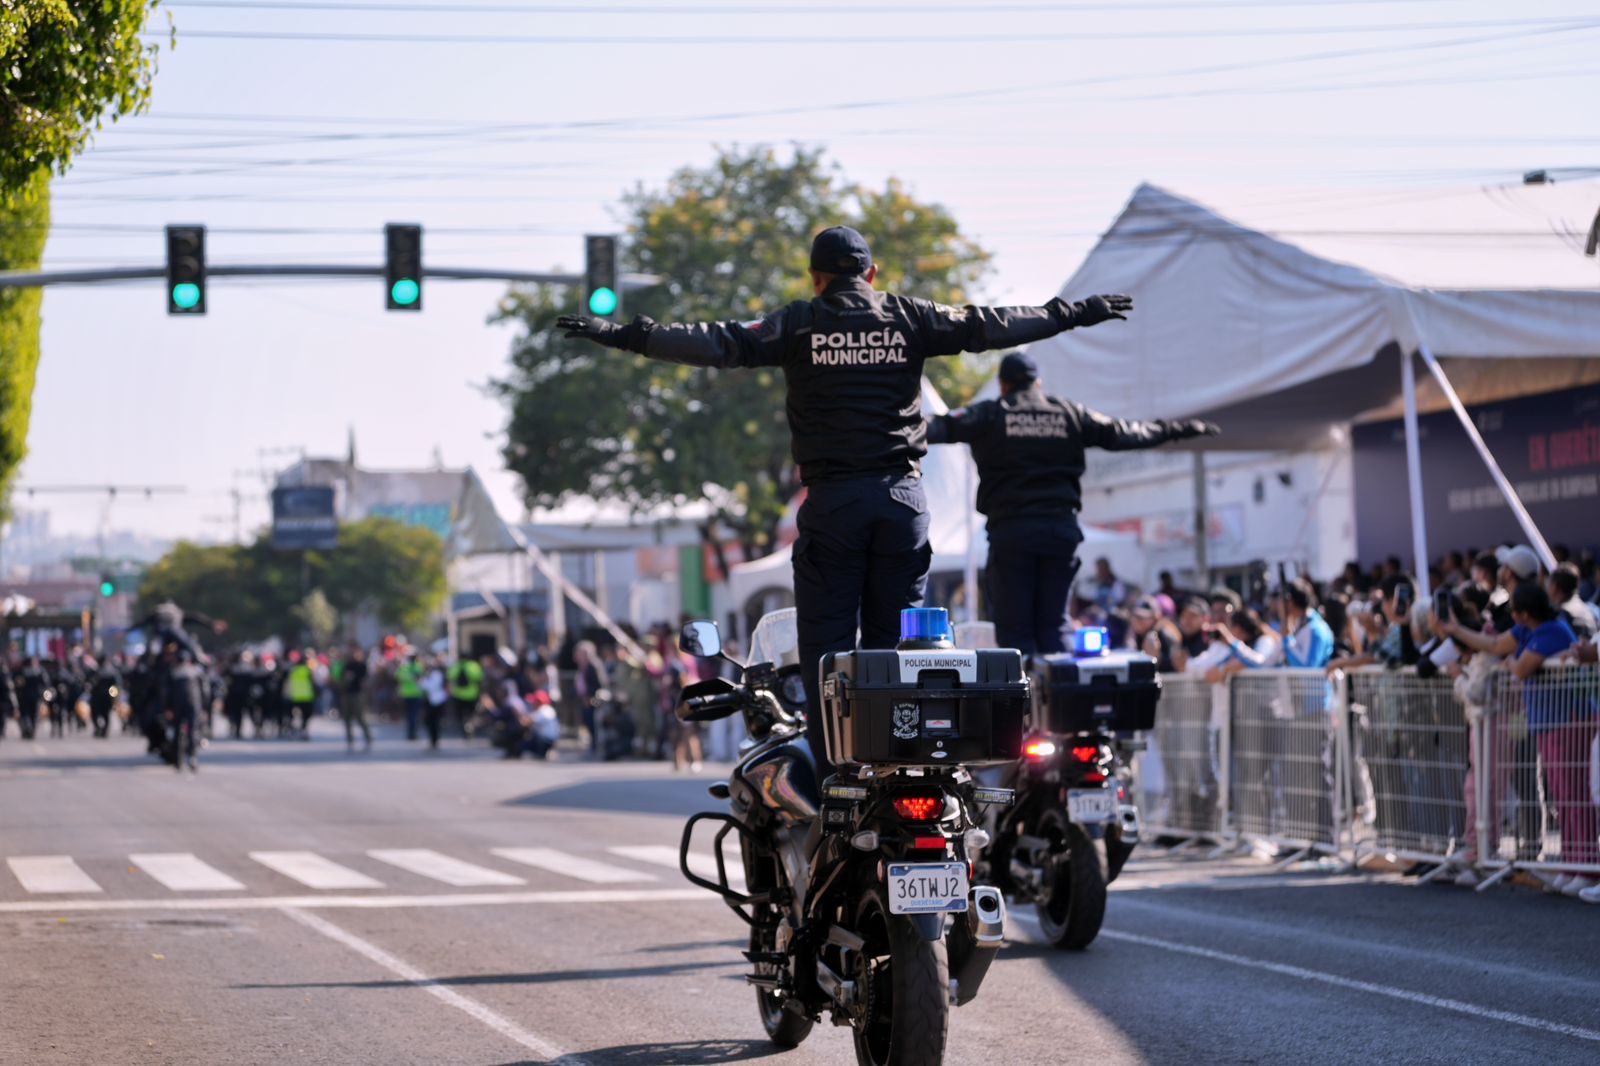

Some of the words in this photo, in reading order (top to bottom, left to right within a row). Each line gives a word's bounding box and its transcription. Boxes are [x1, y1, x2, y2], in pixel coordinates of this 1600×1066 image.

[811, 326, 907, 349] POLICÍA
[812, 348, 907, 365] MUNICIPAL
[934, 658, 972, 668] MUNICIPAL
[897, 877, 959, 899] 36TWJ2
